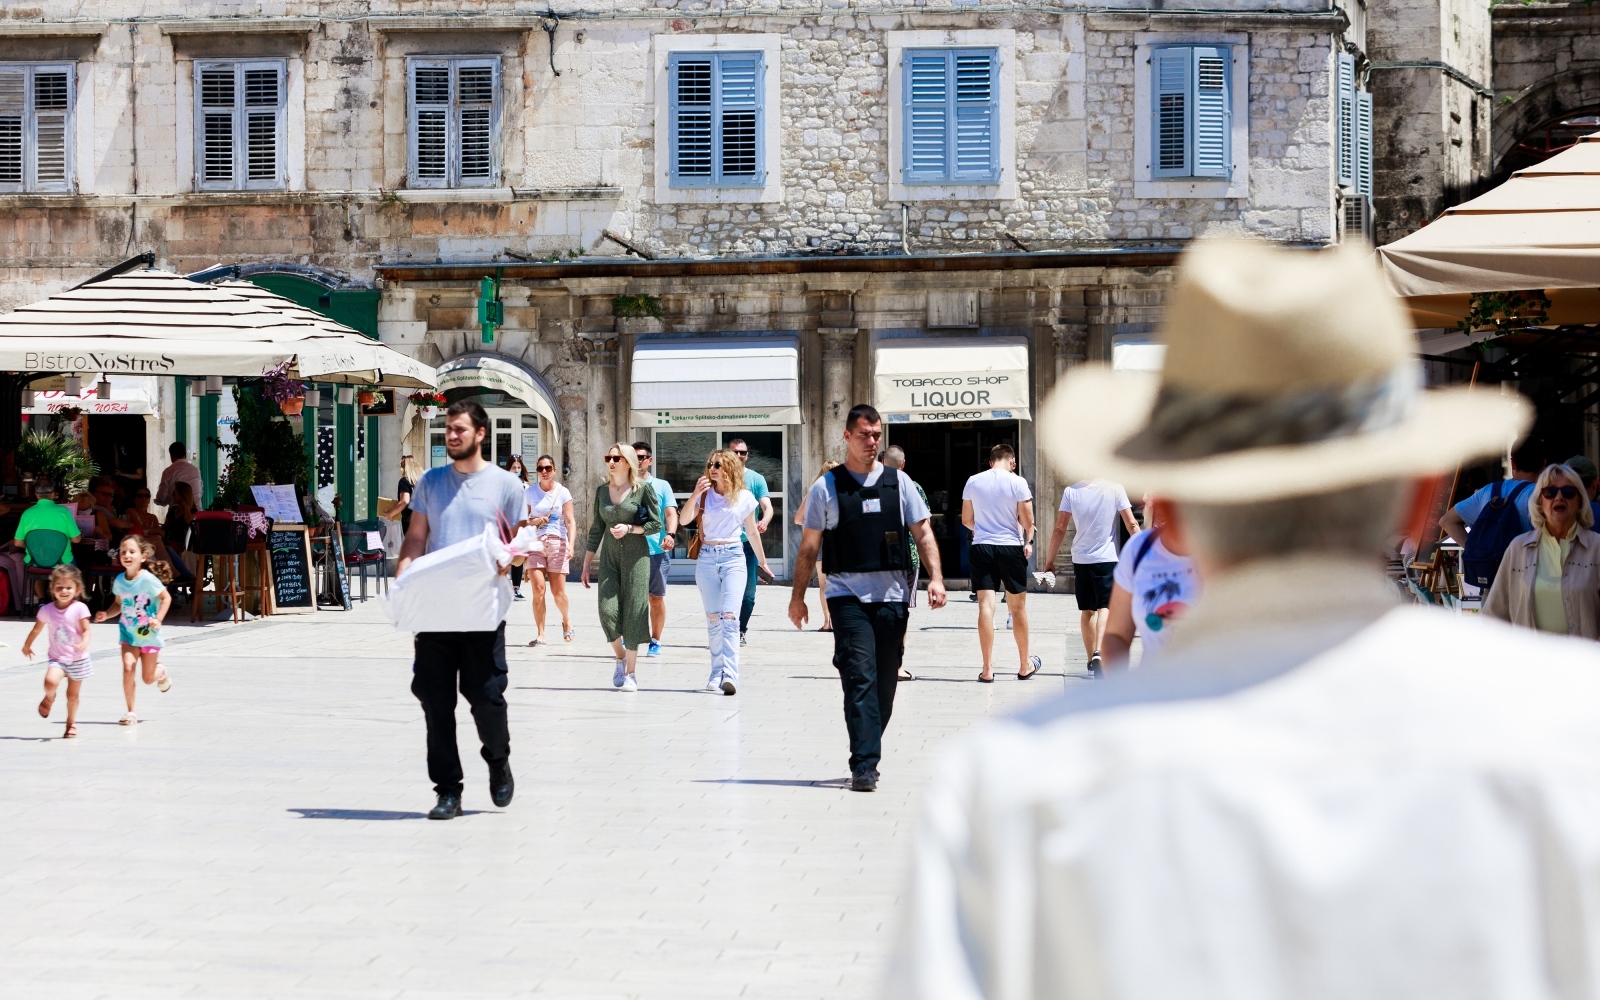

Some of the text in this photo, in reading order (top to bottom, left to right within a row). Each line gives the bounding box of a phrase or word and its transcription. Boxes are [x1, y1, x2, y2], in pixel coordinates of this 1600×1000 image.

[892, 375, 1009, 387] TOBACCO SHOP
[911, 390, 991, 408] LIQUOR
[94, 402, 128, 412] NORA
[919, 411, 982, 421] TOBACCO
